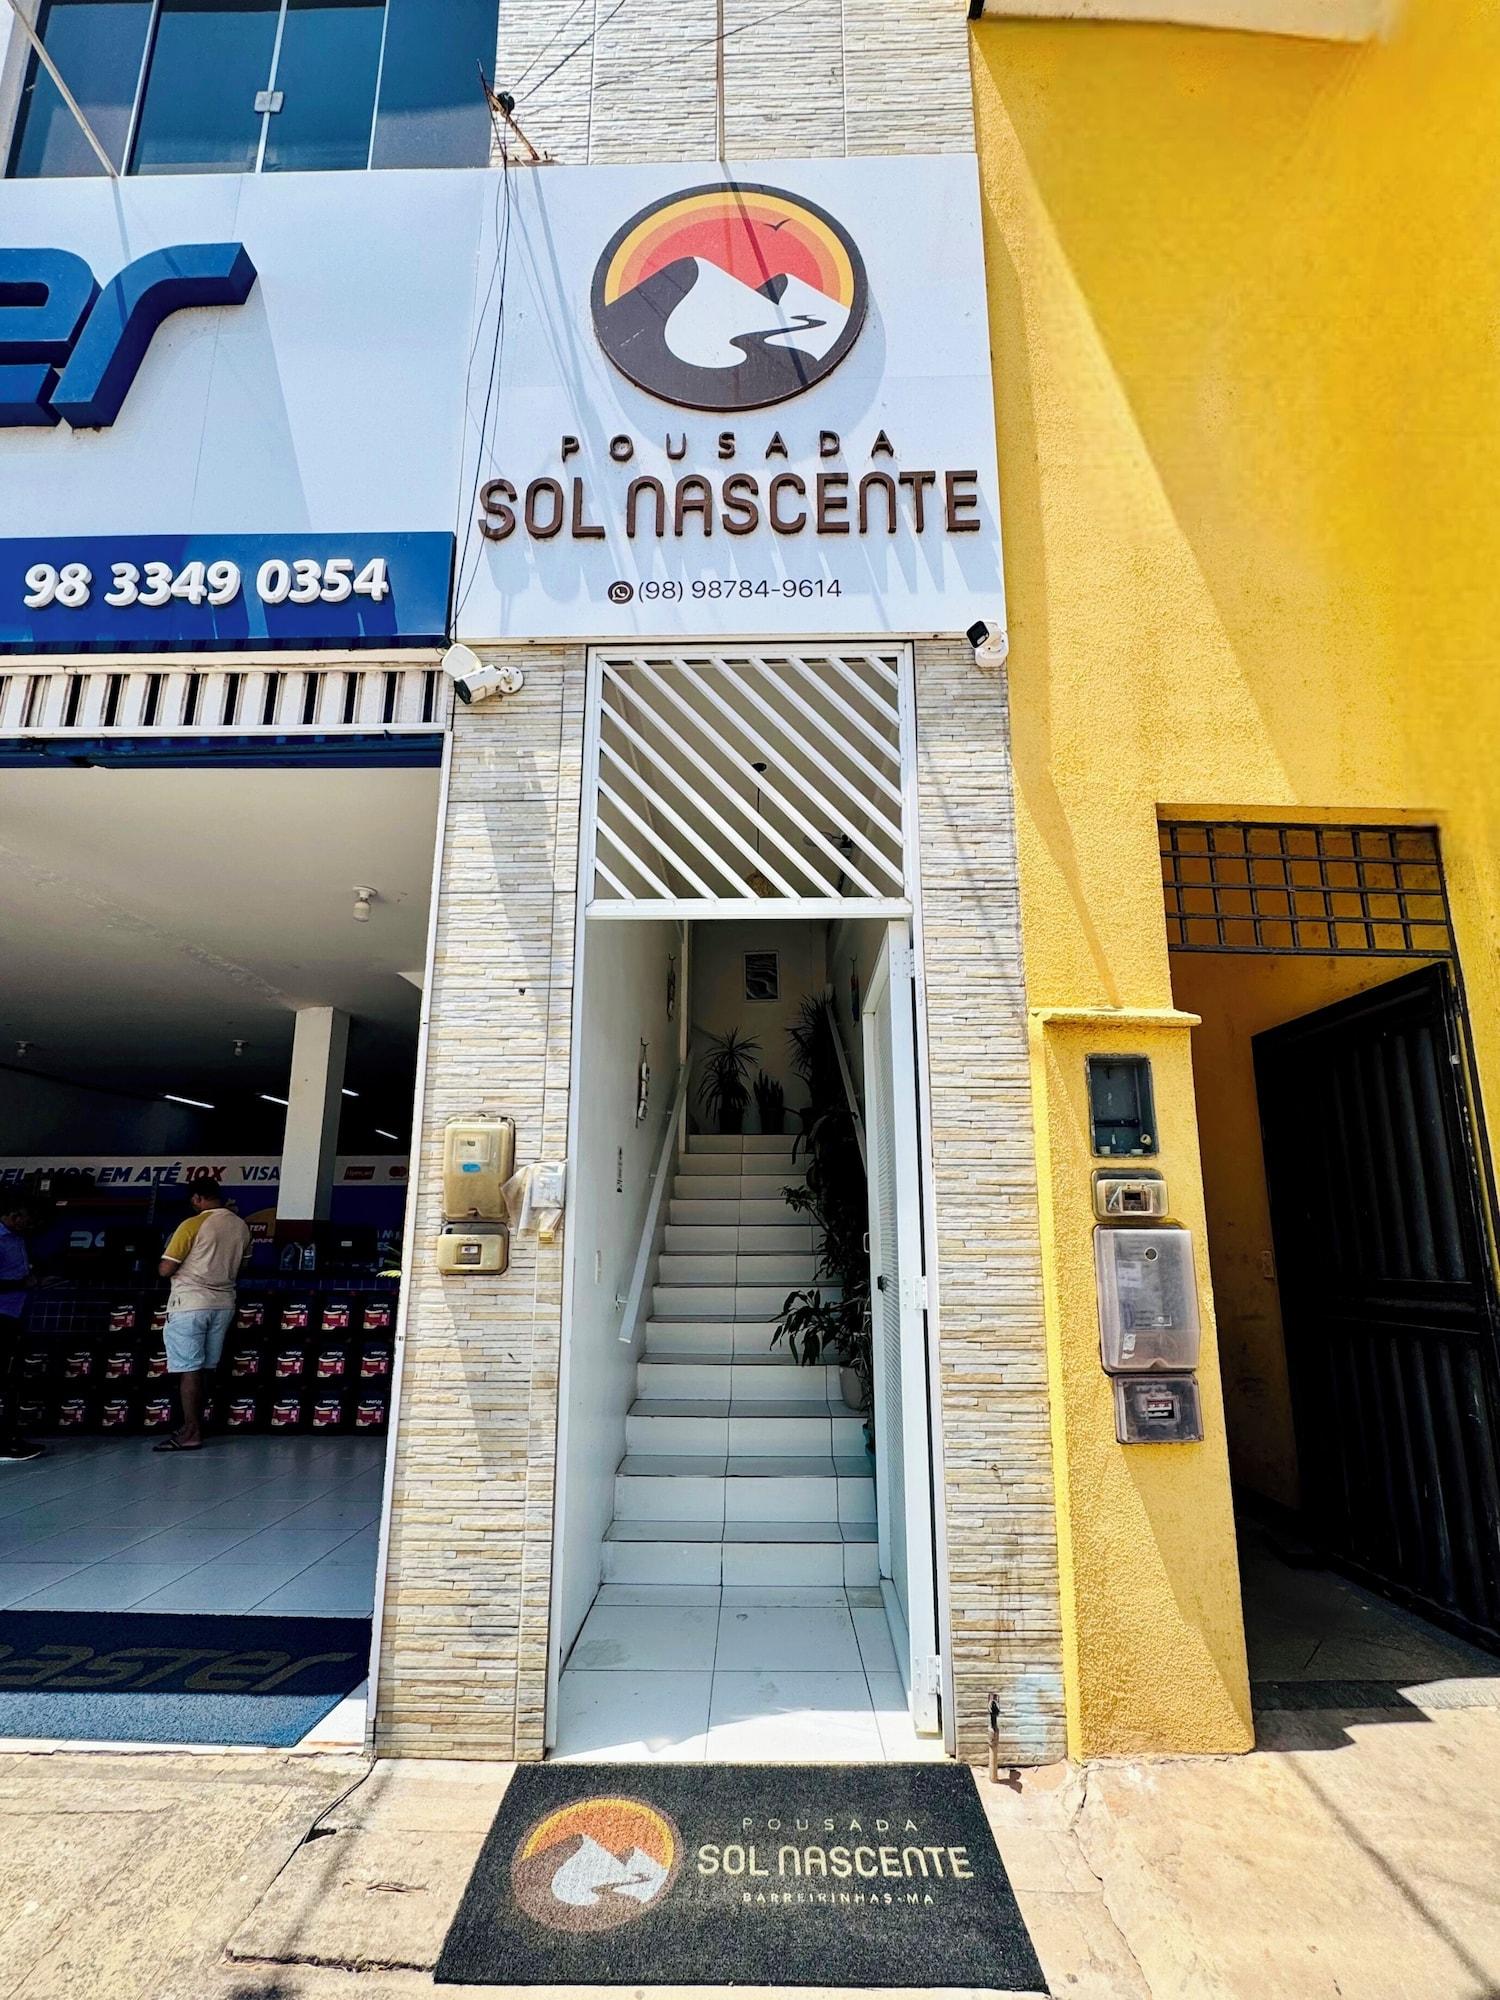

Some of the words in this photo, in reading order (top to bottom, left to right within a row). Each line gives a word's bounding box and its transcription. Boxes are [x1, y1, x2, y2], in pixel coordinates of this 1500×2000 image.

[562, 429, 895, 462] POUSADA
[479, 476, 605, 540] SOL
[626, 470, 981, 538] NASCENTE
[24, 562, 91, 608] 98
[104, 560, 241, 606] 3349
[256, 558, 389, 604] 0354
[637, 581, 684, 603] (98)
[691, 579, 843, 600] 98784-9614
[98, 1167, 132, 1183] EM
[135, 1161, 181, 1184] ATÉ
[240, 1166, 280, 1181] VISA
[744, 1817, 918, 1832] POUSADA
[697, 1844, 769, 1876] SOL
[778, 1845, 975, 1878] NASCENTE
